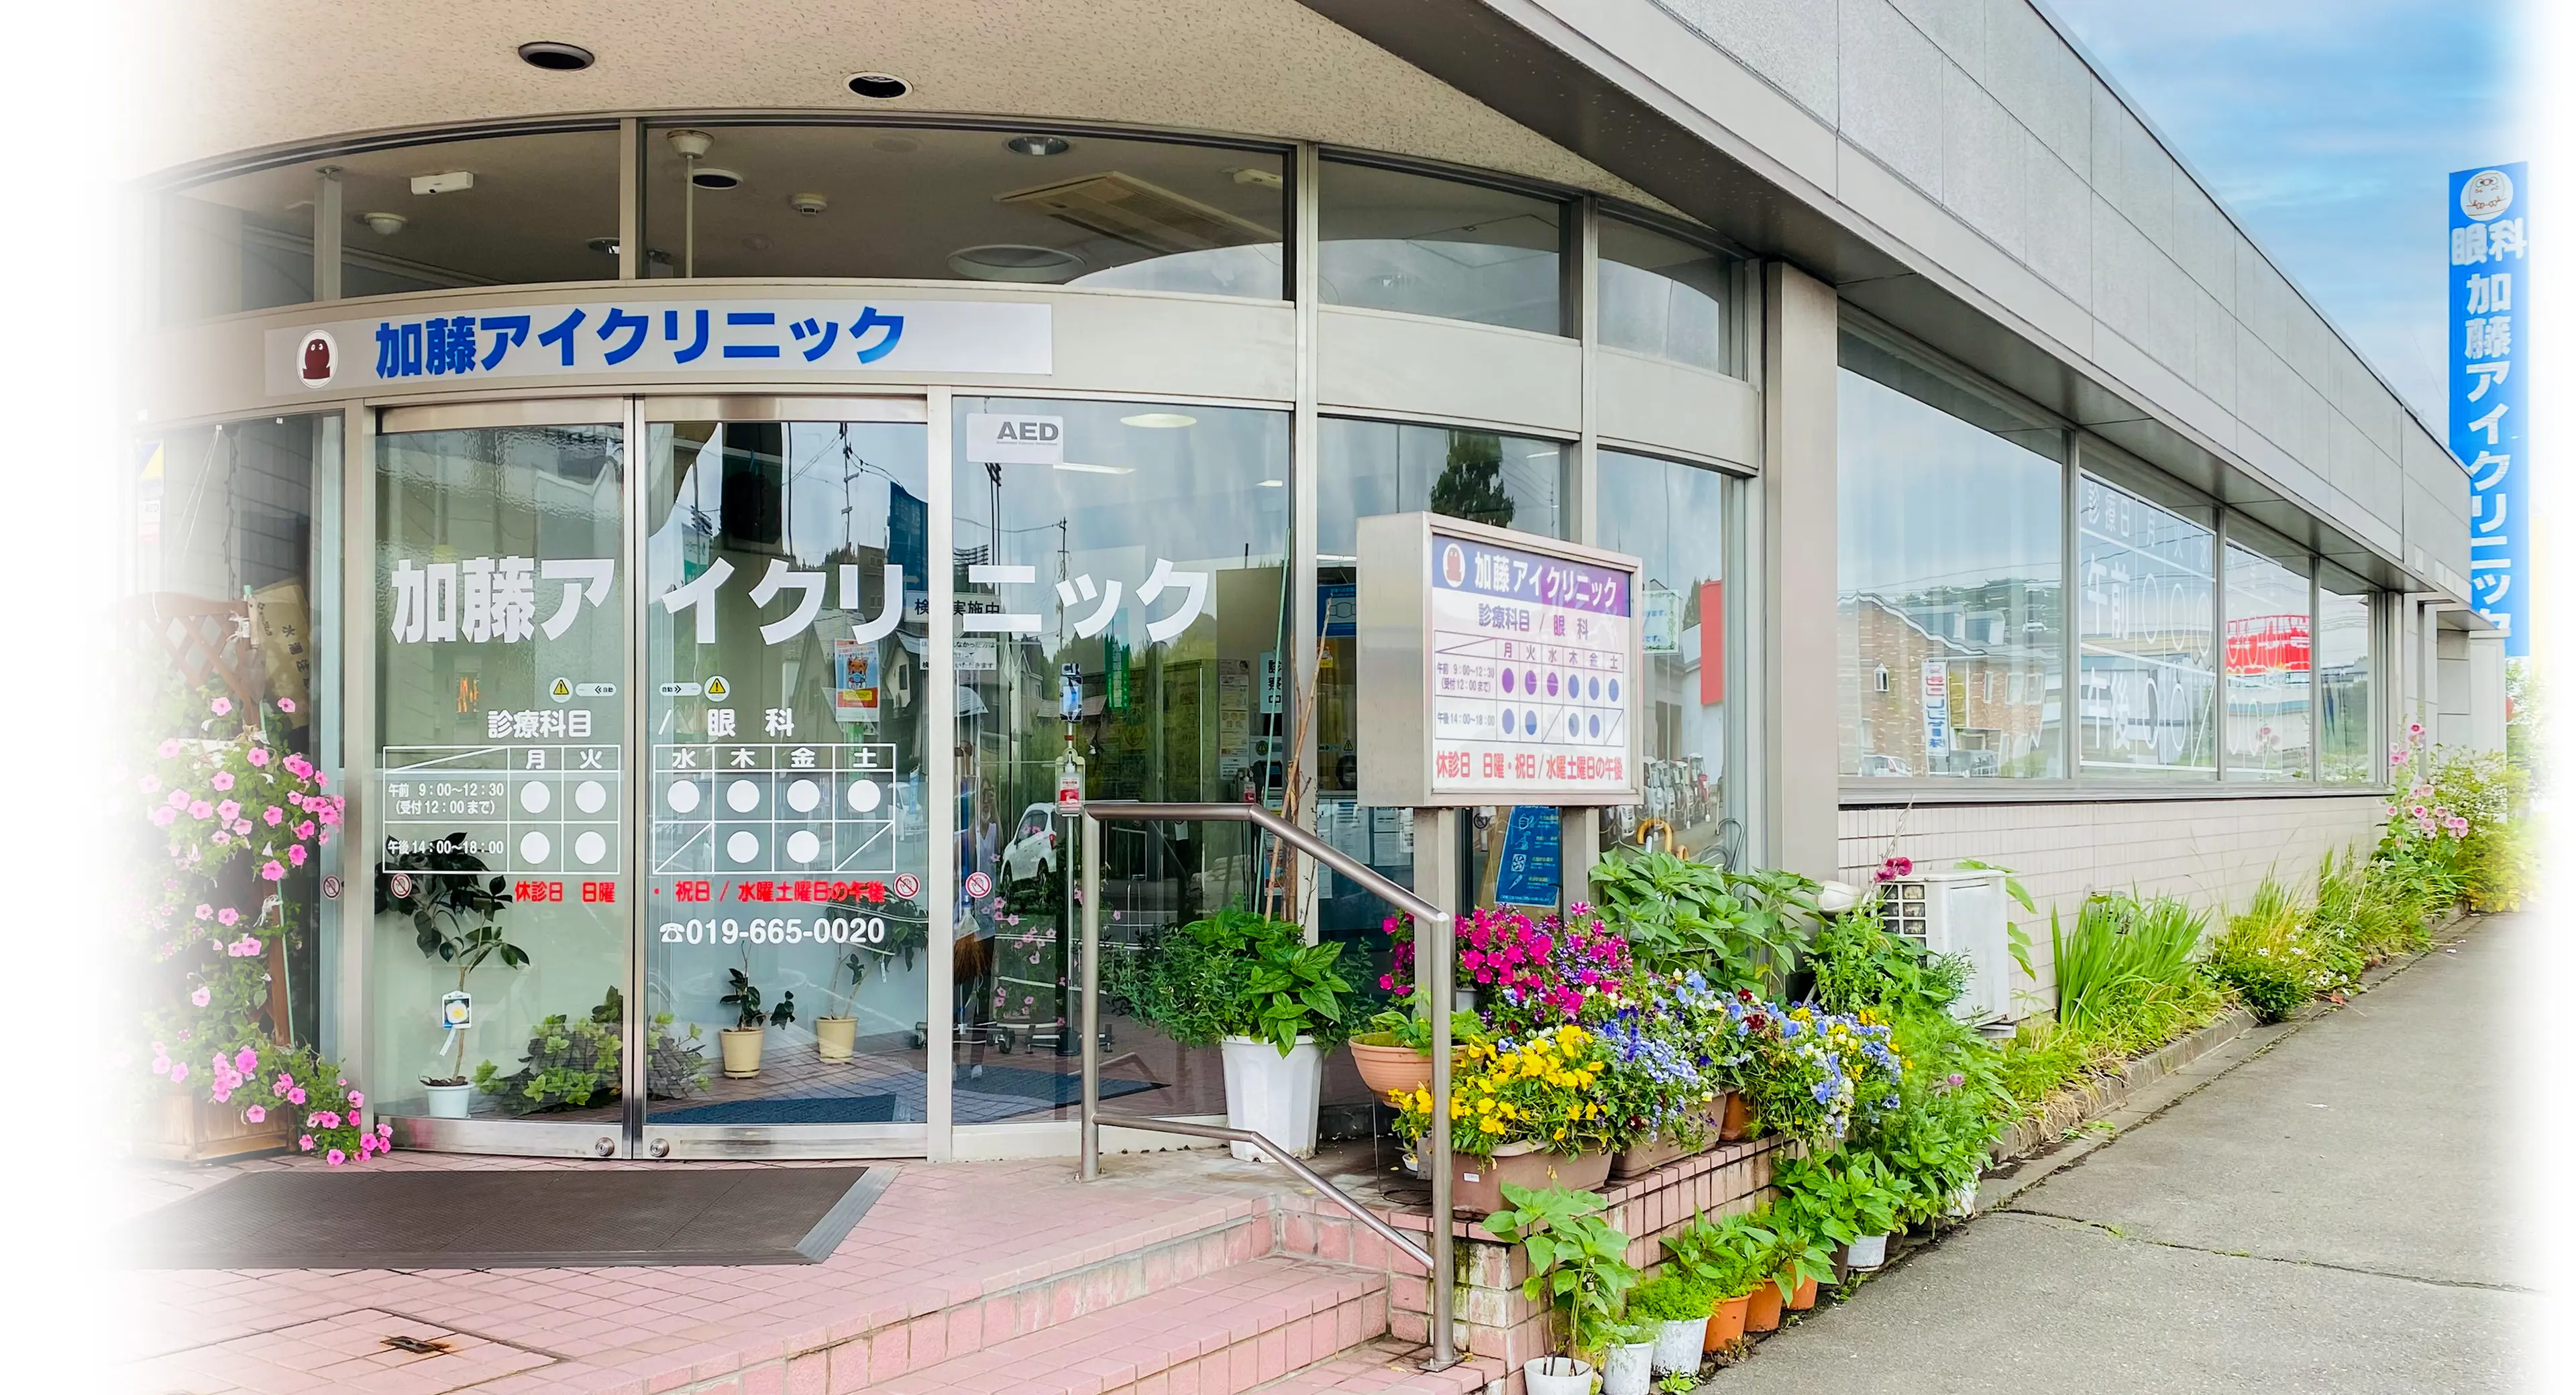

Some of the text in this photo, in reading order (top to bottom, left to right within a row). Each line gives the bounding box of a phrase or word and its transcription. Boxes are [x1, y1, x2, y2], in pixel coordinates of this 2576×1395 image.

[2452, 218, 2527, 266] 眼科
[375, 306, 904, 379] 加藤アイクリニック
[997, 421, 1059, 441] AED
[1474, 551, 1617, 607] 加藤アイクリニック
[914, 598, 1000, 616] 検実施中
[1478, 603, 1530, 632] 診療科目
[1437, 662, 1450, 675] 午前
[1503, 642, 1618, 670] 月 火 水 木 金 土
[487, 709, 592, 738] 診療科目
[525, 747, 877, 770] 月 火 水 木 金 土
[1436, 750, 1470, 778] 休診日
[388, 783, 410, 797] 午前
[515, 881, 564, 902] 休診日
[738, 881, 885, 903] 水曜土曜日の午後
